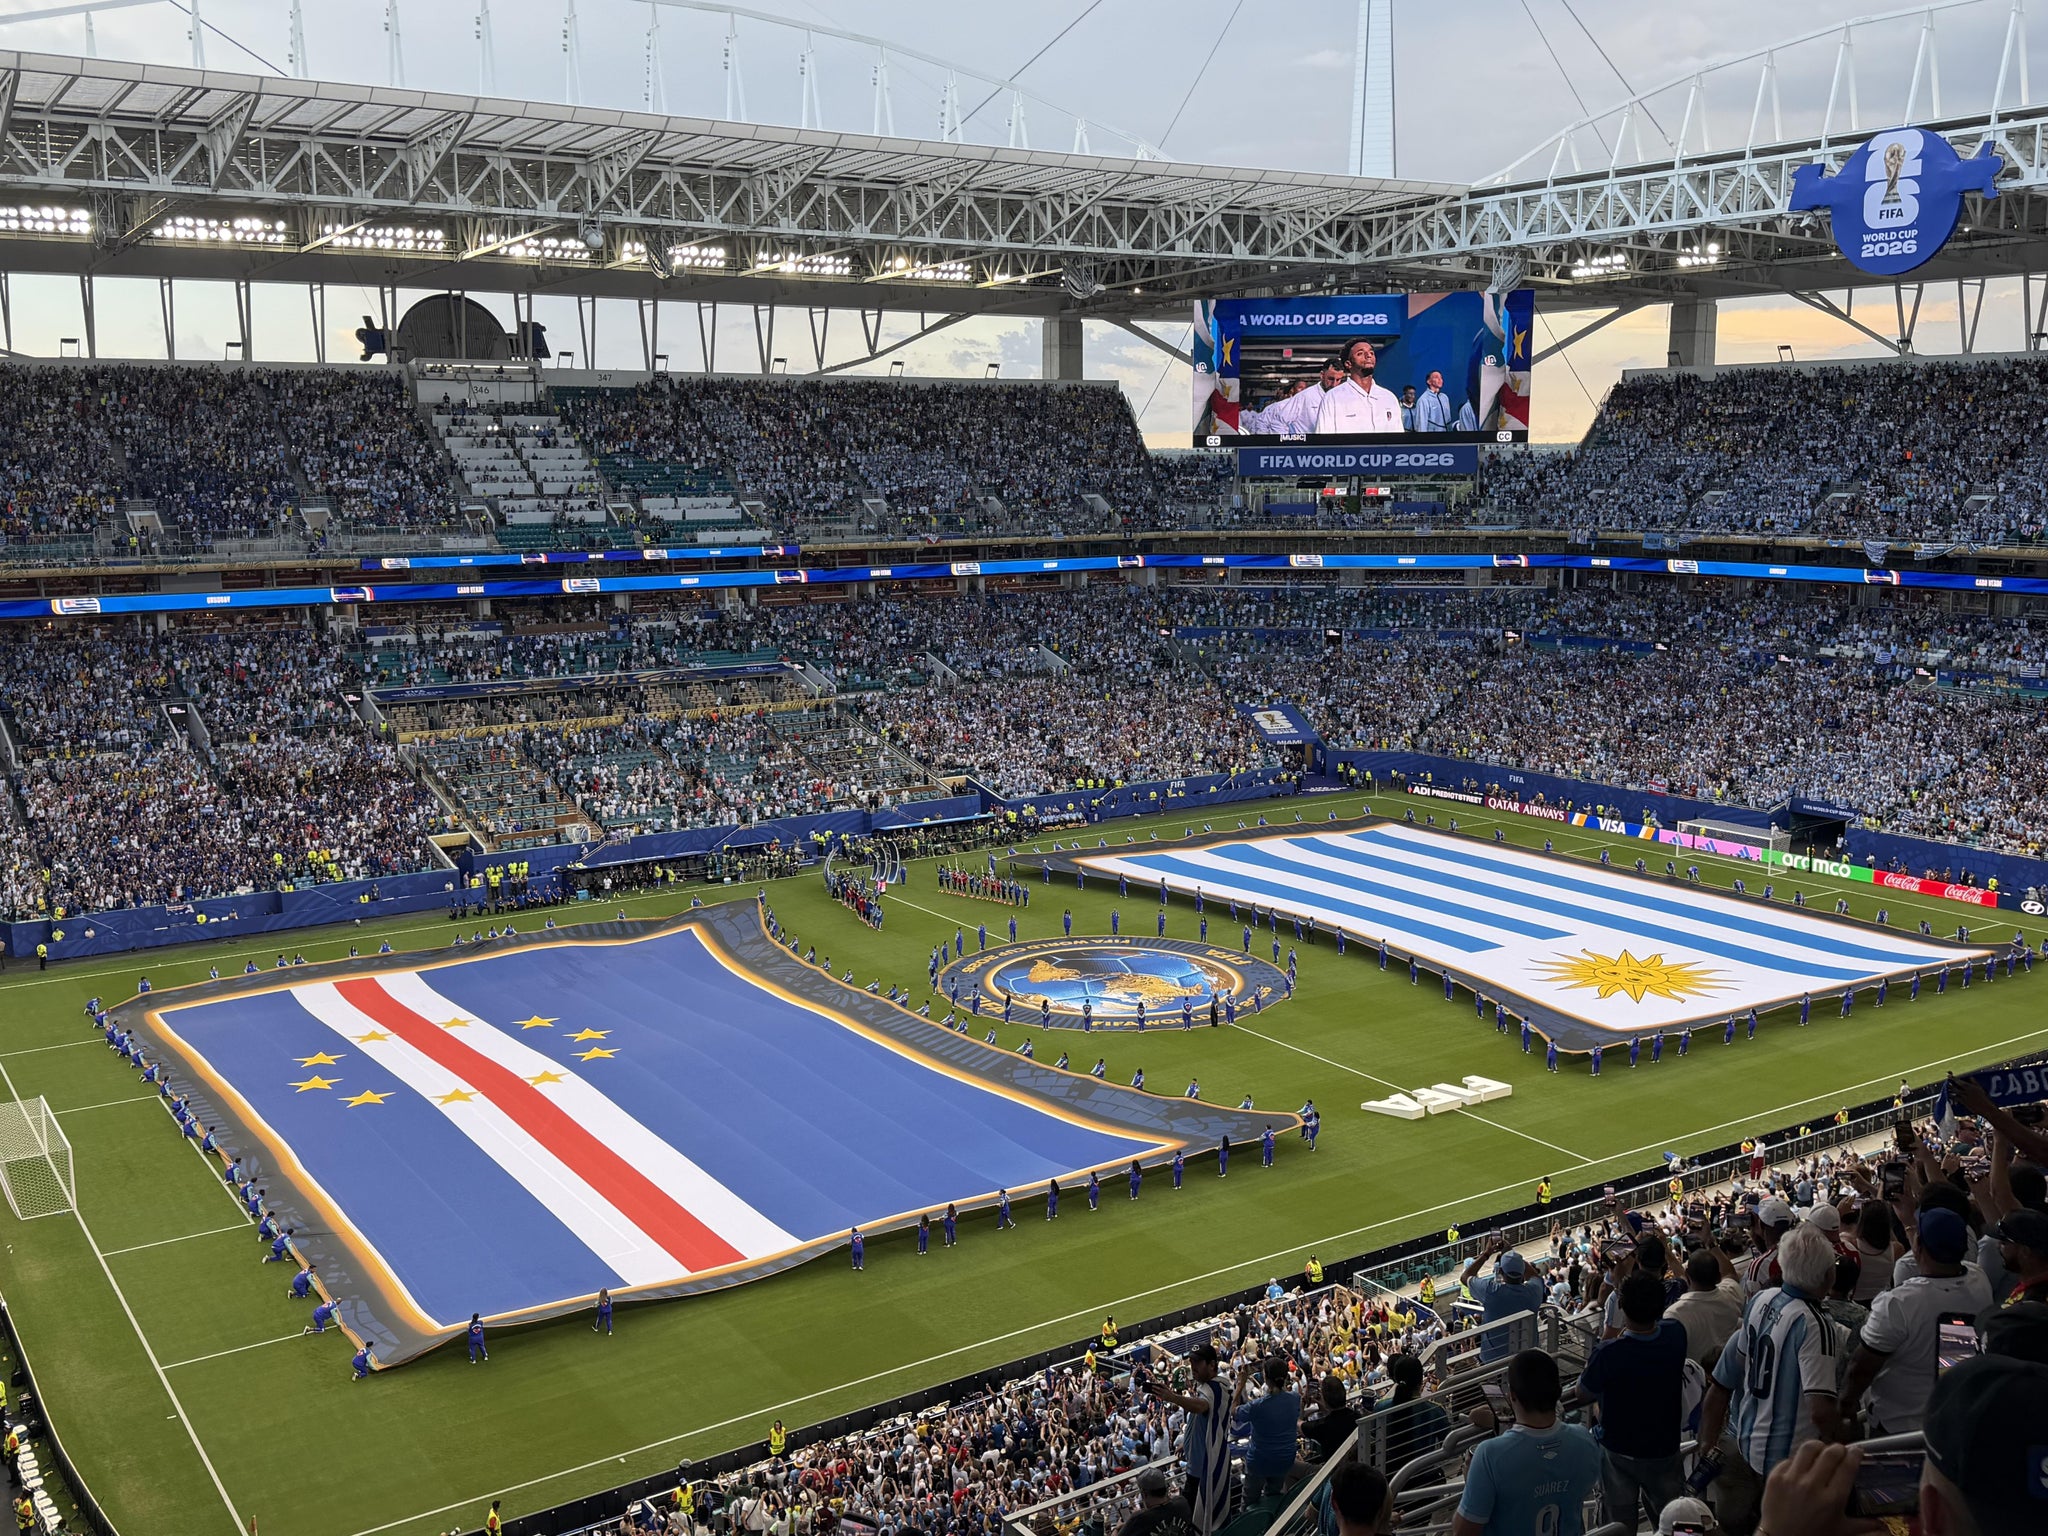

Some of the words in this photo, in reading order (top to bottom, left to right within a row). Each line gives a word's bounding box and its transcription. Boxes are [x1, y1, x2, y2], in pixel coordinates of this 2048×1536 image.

[1879, 208, 1904, 220] FIFA
[1863, 232, 1897, 242] WORLD
[1899, 229, 1918, 240] CUP
[1861, 240, 1917, 258] 2026
[1250, 314, 1303, 326] WORLD
[1306, 314, 1335, 326] CUP
[1337, 313, 1388, 325] 2026
[598, 373, 612, 382] 347
[473, 385, 490, 394] 346
[1207, 437, 1220, 445] CC
[1280, 433, 1306, 442] [MUSIC]
[1498, 432, 1511, 441] CC
[1260, 455, 1294, 468] FIFA
[1298, 455, 1356, 468] WORLD
[1359, 454, 1393, 467] CUP
[1396, 453, 1454, 466] 2026
[1171, 780, 1186, 788] FIFA
[1509, 774, 1524, 784] FIFA
[1413, 785, 1430, 796] ADI
[1488, 797, 1520, 813] QATAR
[1523, 804, 1565, 821] AIRWAYS
[1596, 817, 1626, 835] VISA
